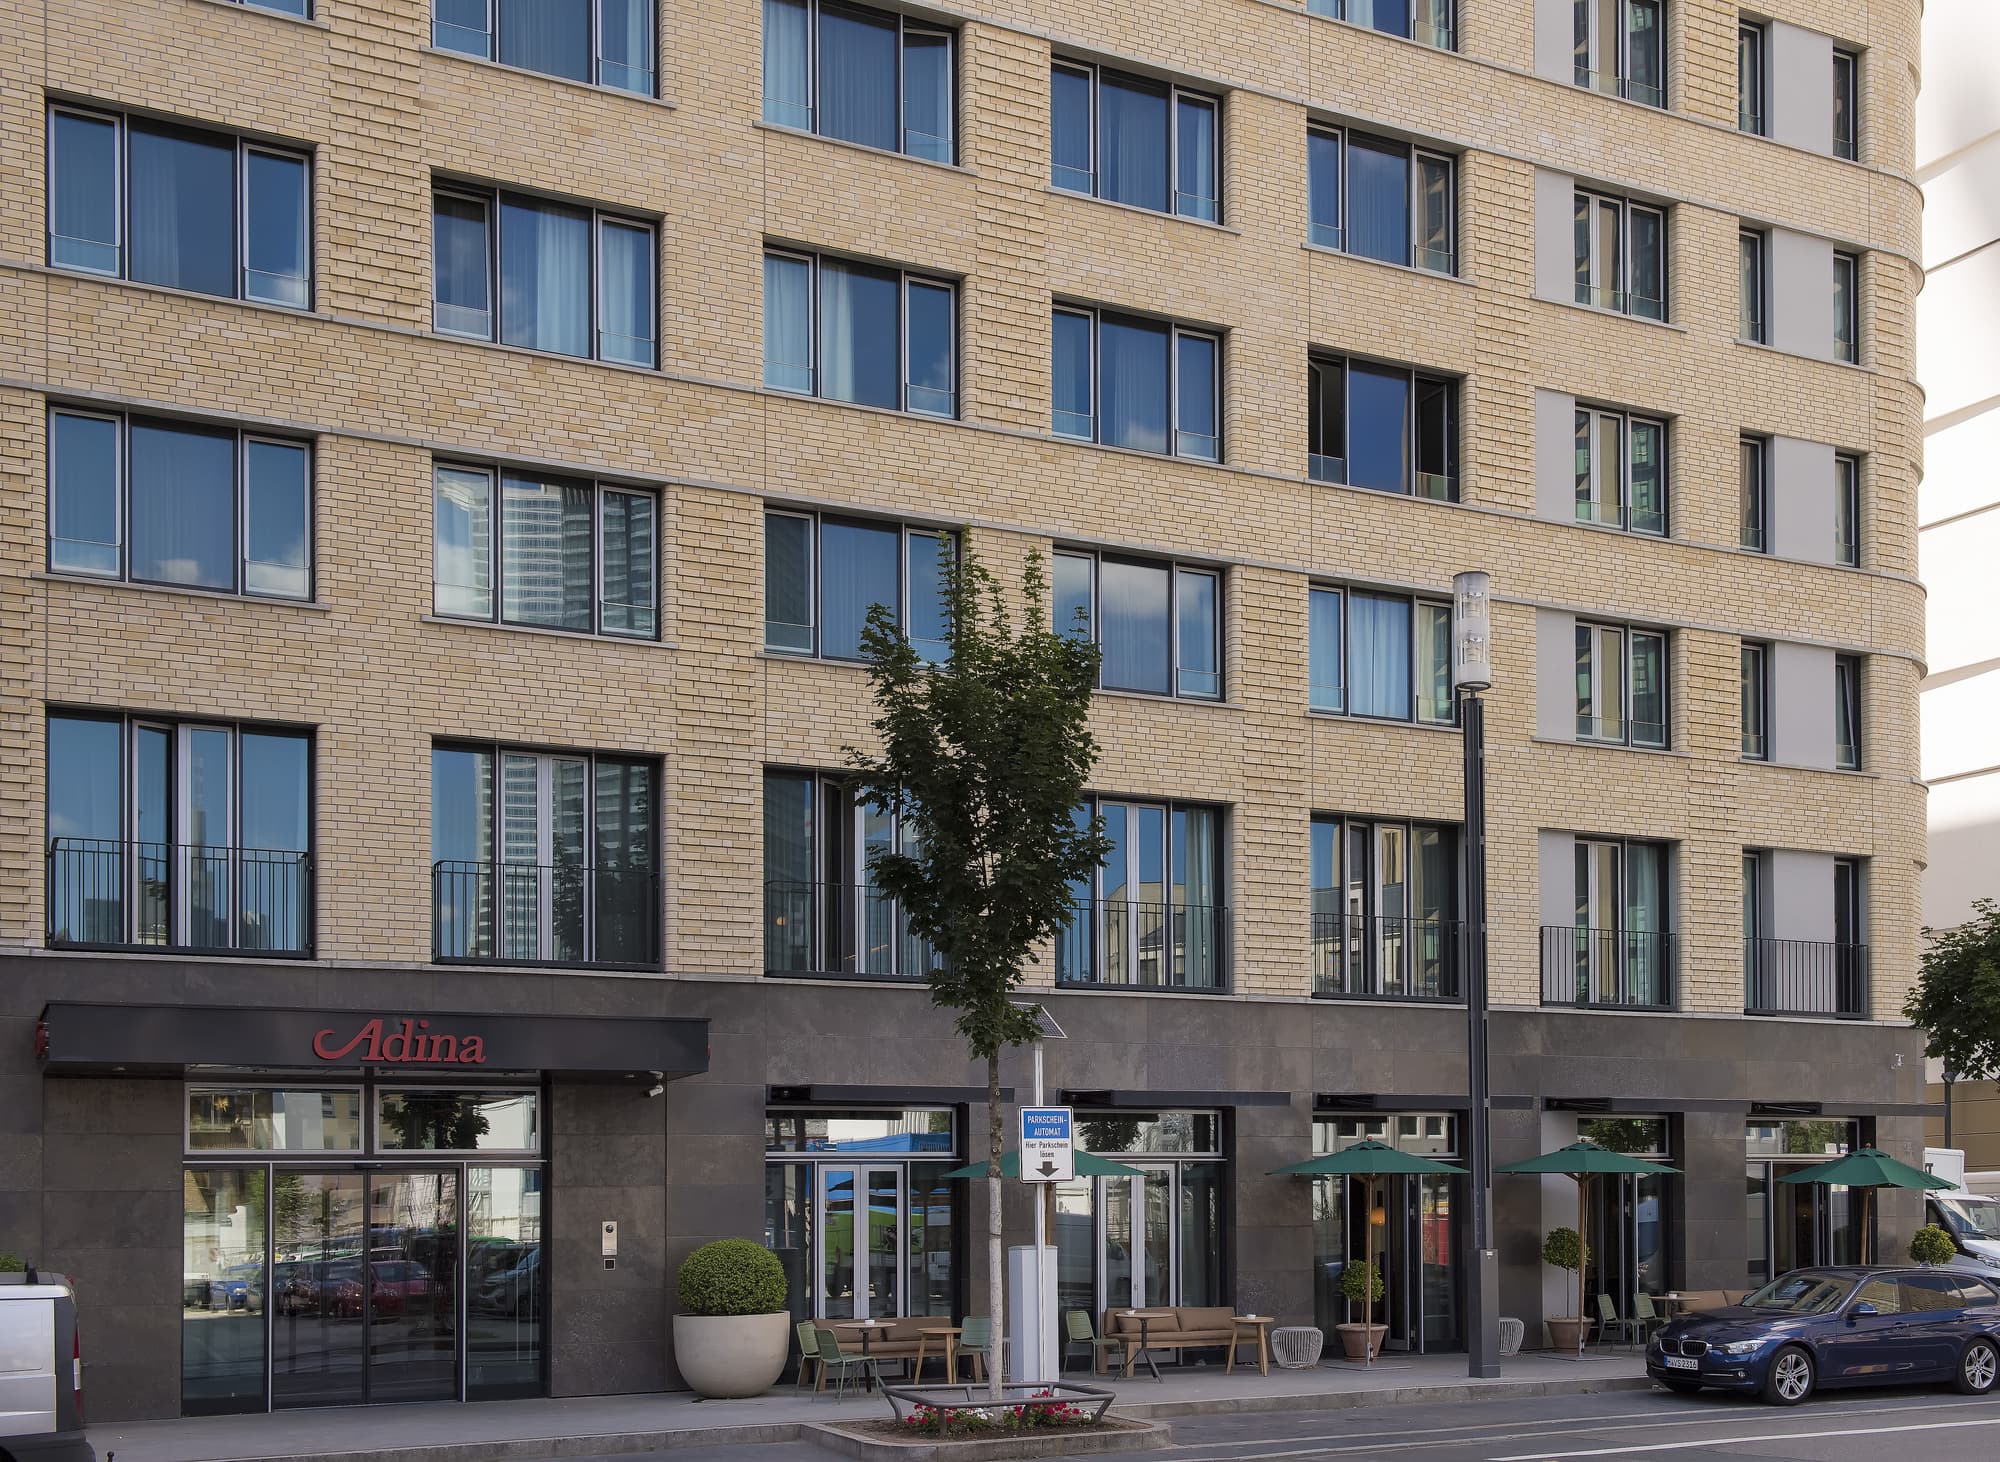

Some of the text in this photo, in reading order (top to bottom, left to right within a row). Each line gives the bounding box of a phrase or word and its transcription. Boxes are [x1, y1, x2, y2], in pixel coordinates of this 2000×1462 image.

[313, 1018, 487, 1063] Adina
[1027, 1115, 1068, 1124] PARKSCHEIN-
[1034, 1127, 1061, 1137] AUTOMAT
[1025, 1141, 1069, 1149] Hier Parkschein
